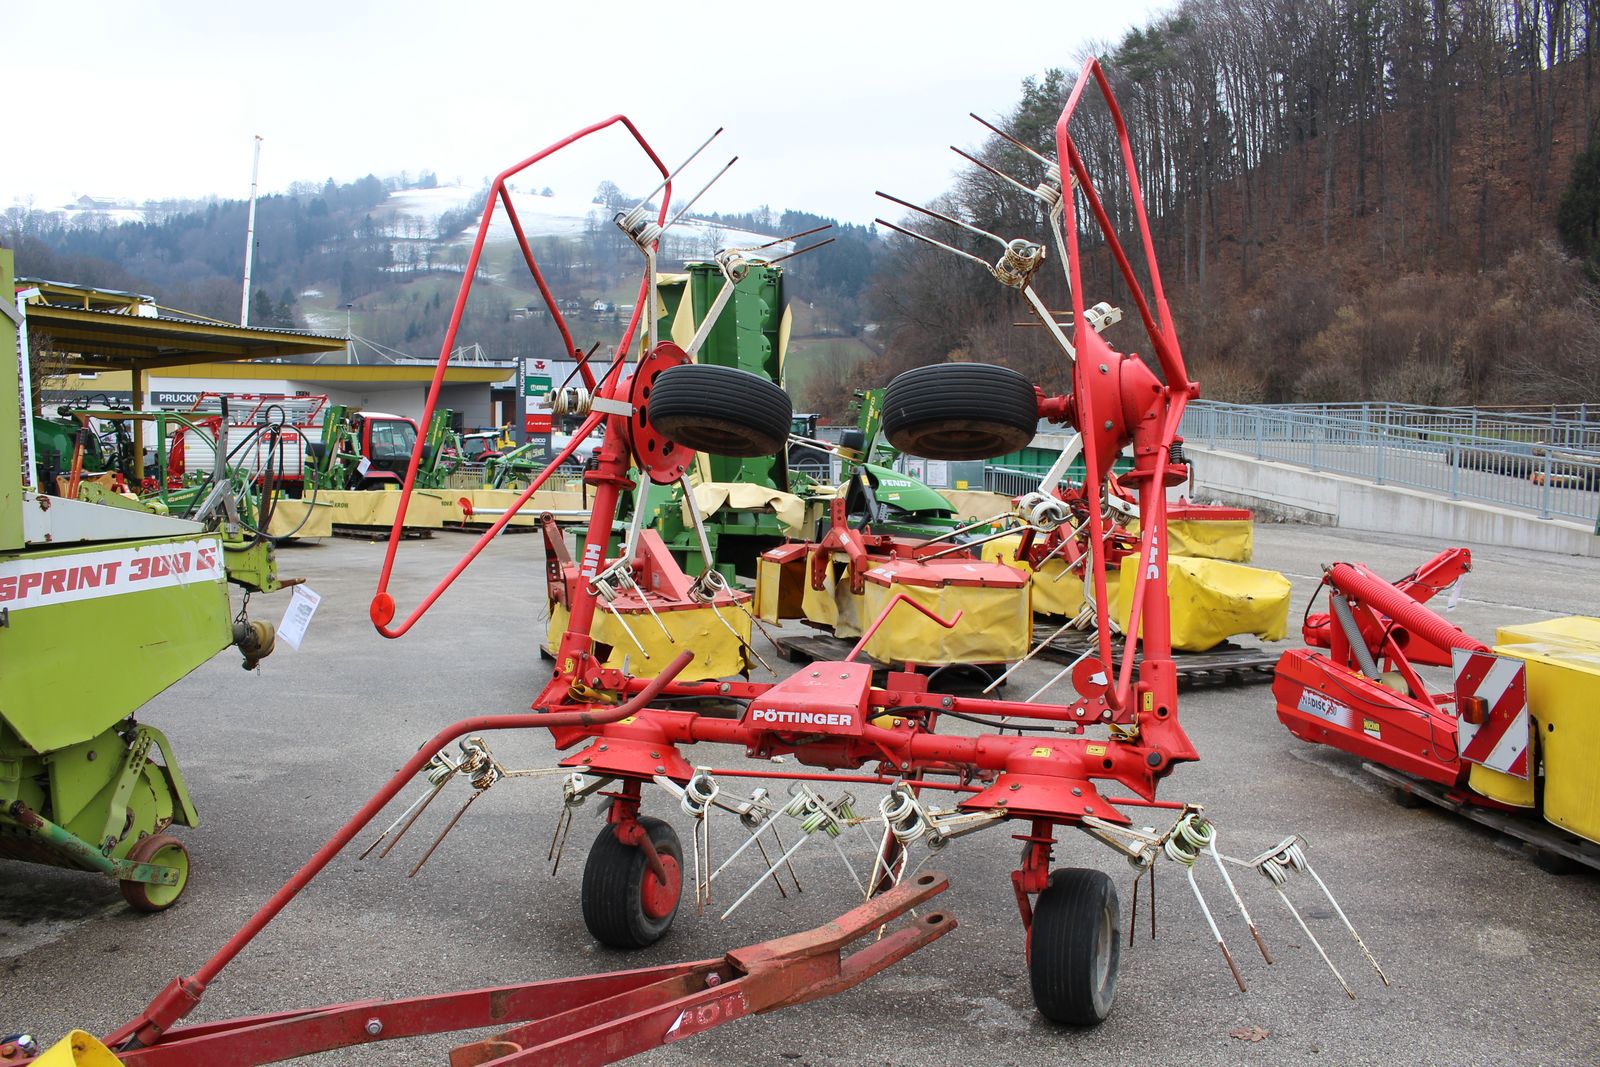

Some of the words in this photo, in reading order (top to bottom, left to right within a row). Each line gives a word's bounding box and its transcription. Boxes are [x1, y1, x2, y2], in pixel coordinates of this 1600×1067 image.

[159, 393, 203, 402] PRUCKN
[0, 561, 122, 601] SPRINT
[129, 551, 191, 582] 300
[581, 543, 602, 581] HIT
[752, 708, 852, 727] PÖTTINGER
